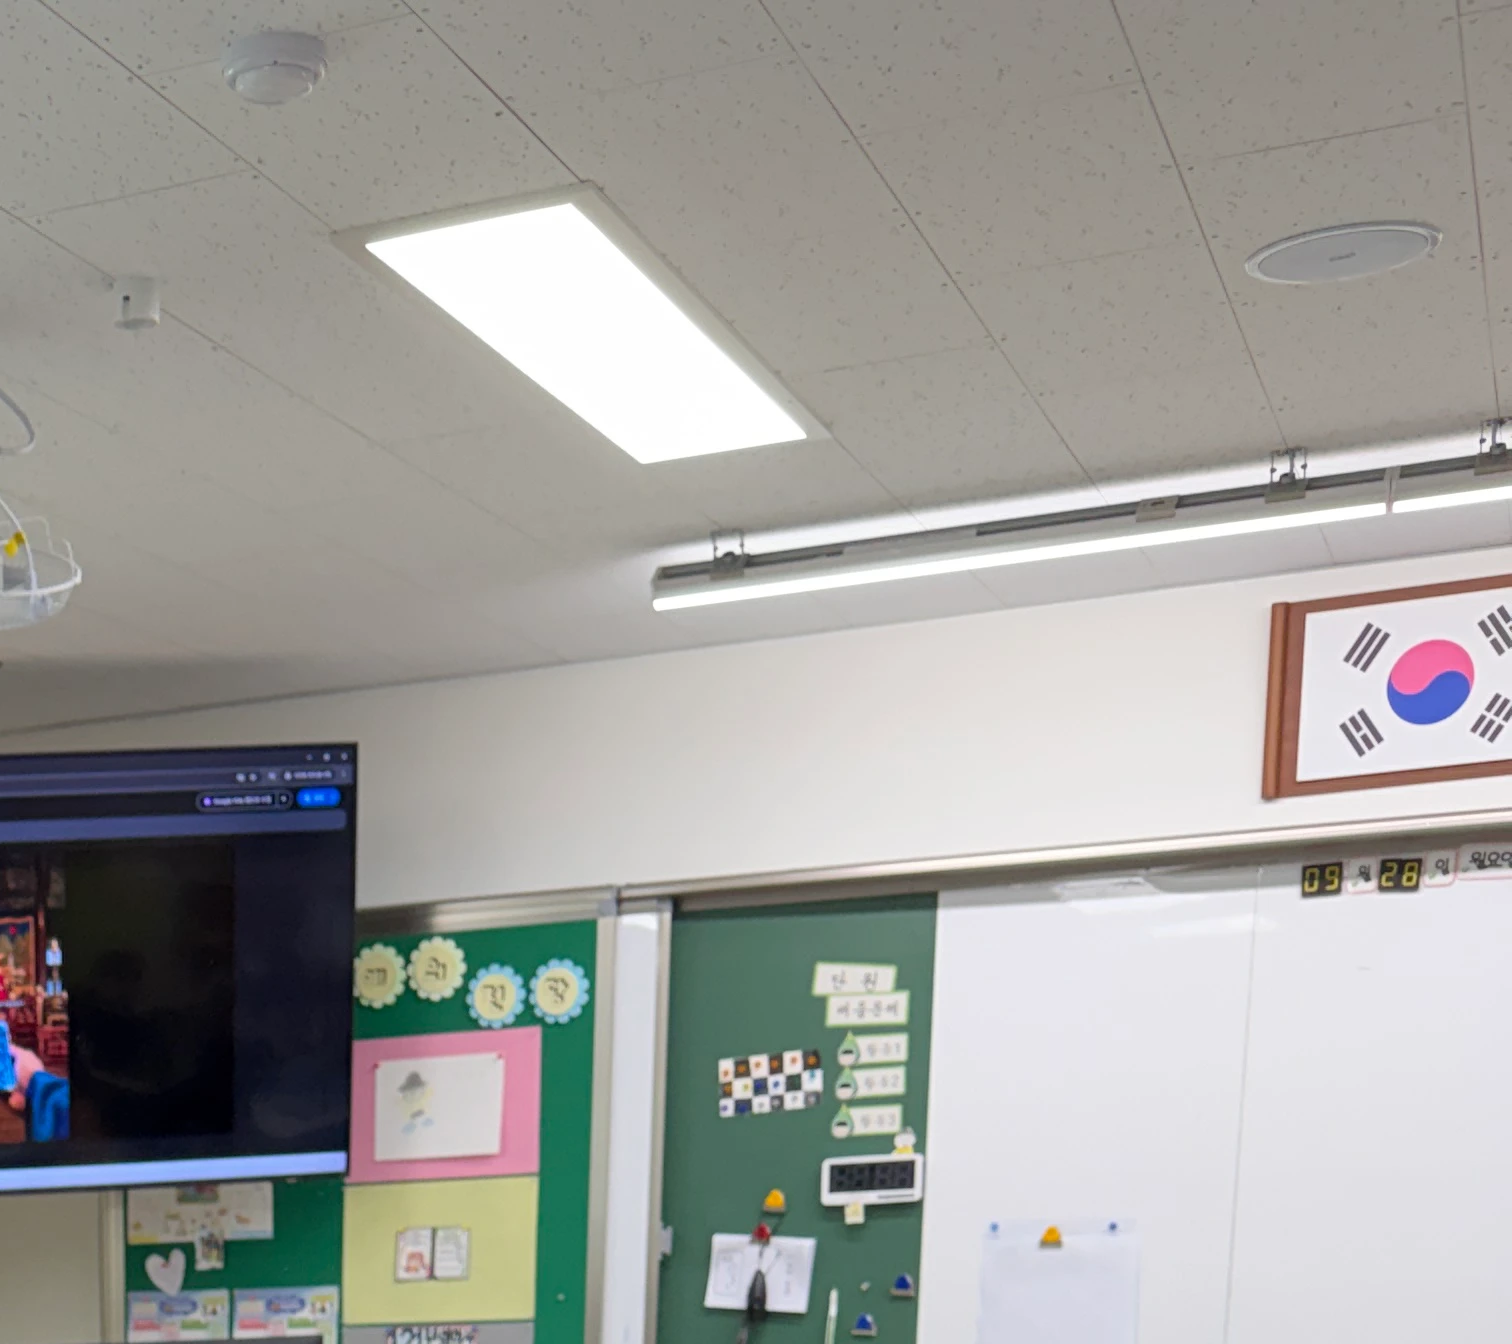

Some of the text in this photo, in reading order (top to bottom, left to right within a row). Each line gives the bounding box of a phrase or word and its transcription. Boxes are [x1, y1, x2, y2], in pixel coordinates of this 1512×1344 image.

[1303, 866, 1340, 894] 09
[1379, 861, 1419, 888] 28
[1434, 857, 1450, 876] 일
